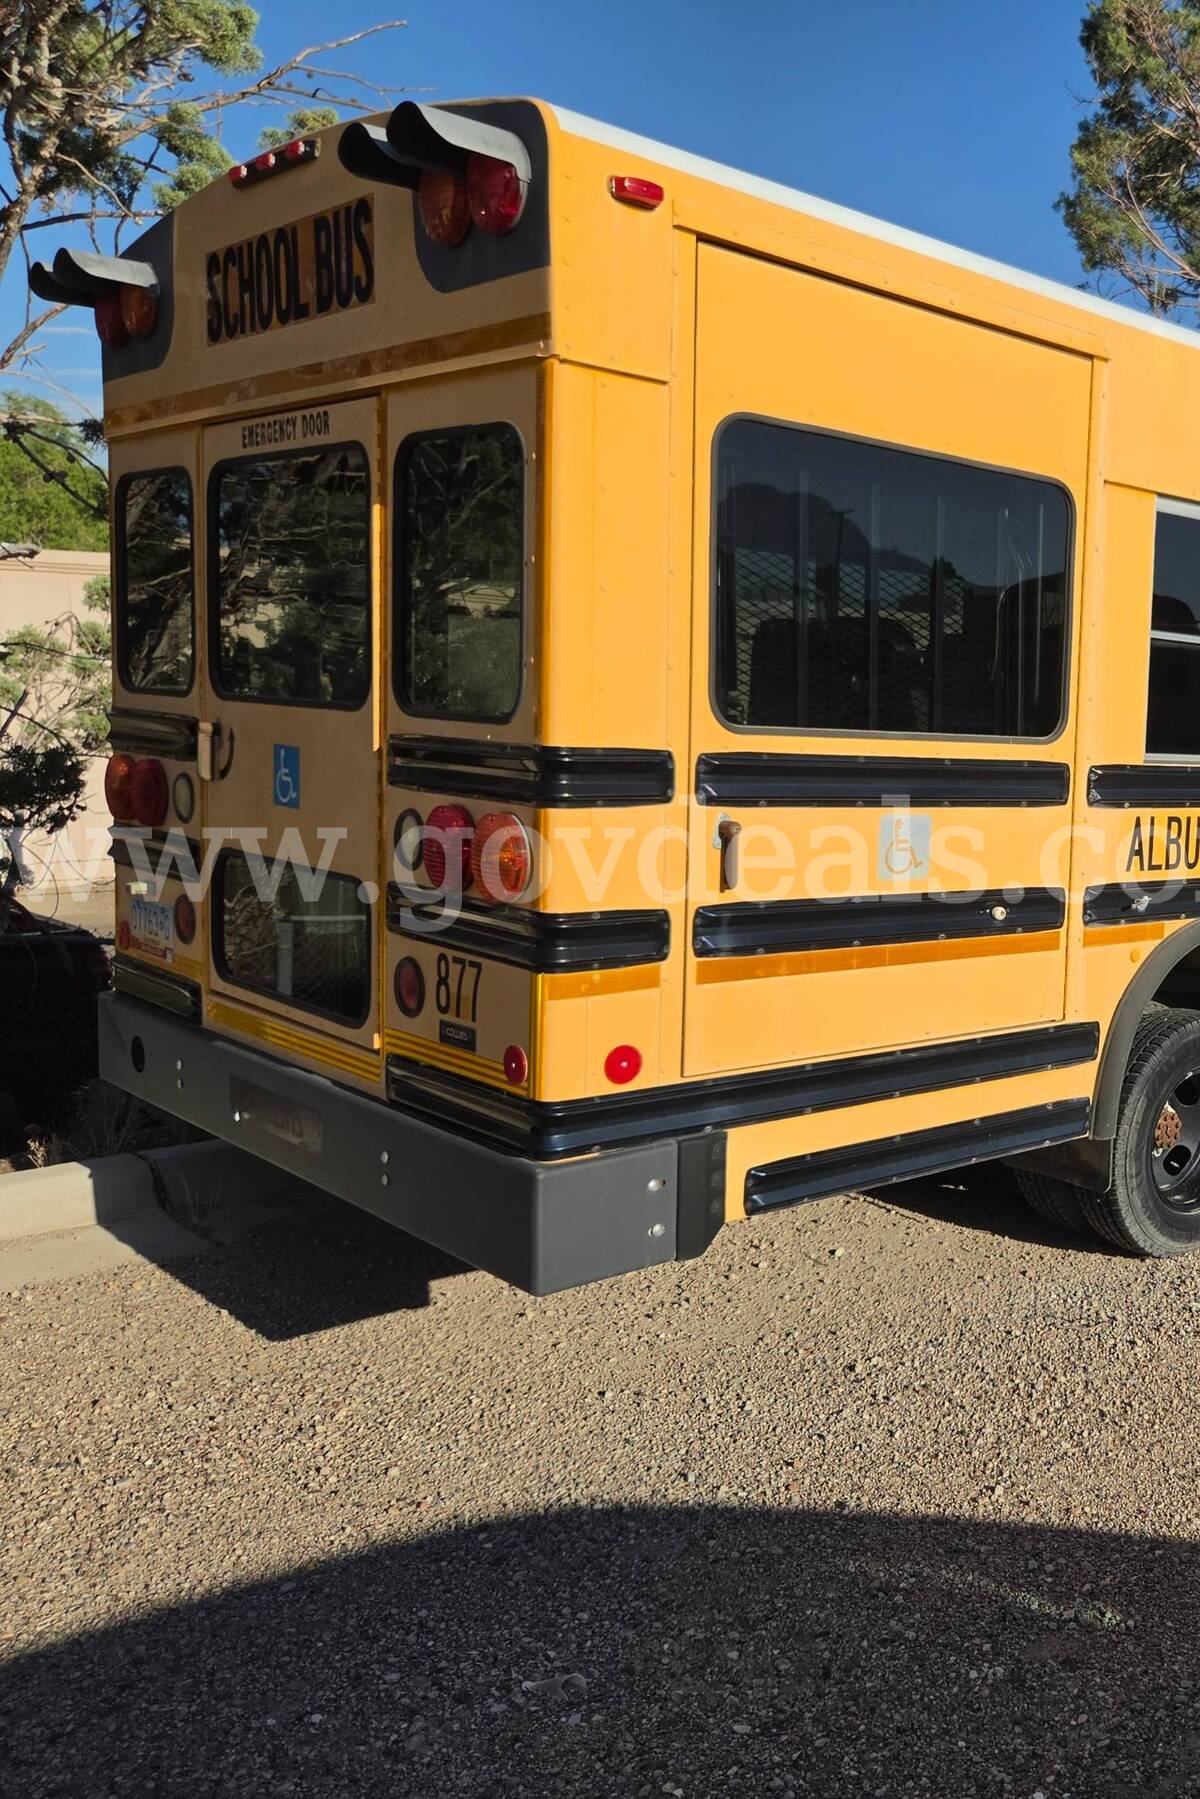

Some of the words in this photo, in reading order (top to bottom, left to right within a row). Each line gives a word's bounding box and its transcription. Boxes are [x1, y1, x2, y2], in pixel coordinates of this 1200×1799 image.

[207, 225, 310, 343] SCHOOL
[314, 198, 374, 315] BUS
[242, 416, 298, 449] EMERGENCY
[301, 410, 330, 439] DOOR
[436, 952, 482, 1023] 877
